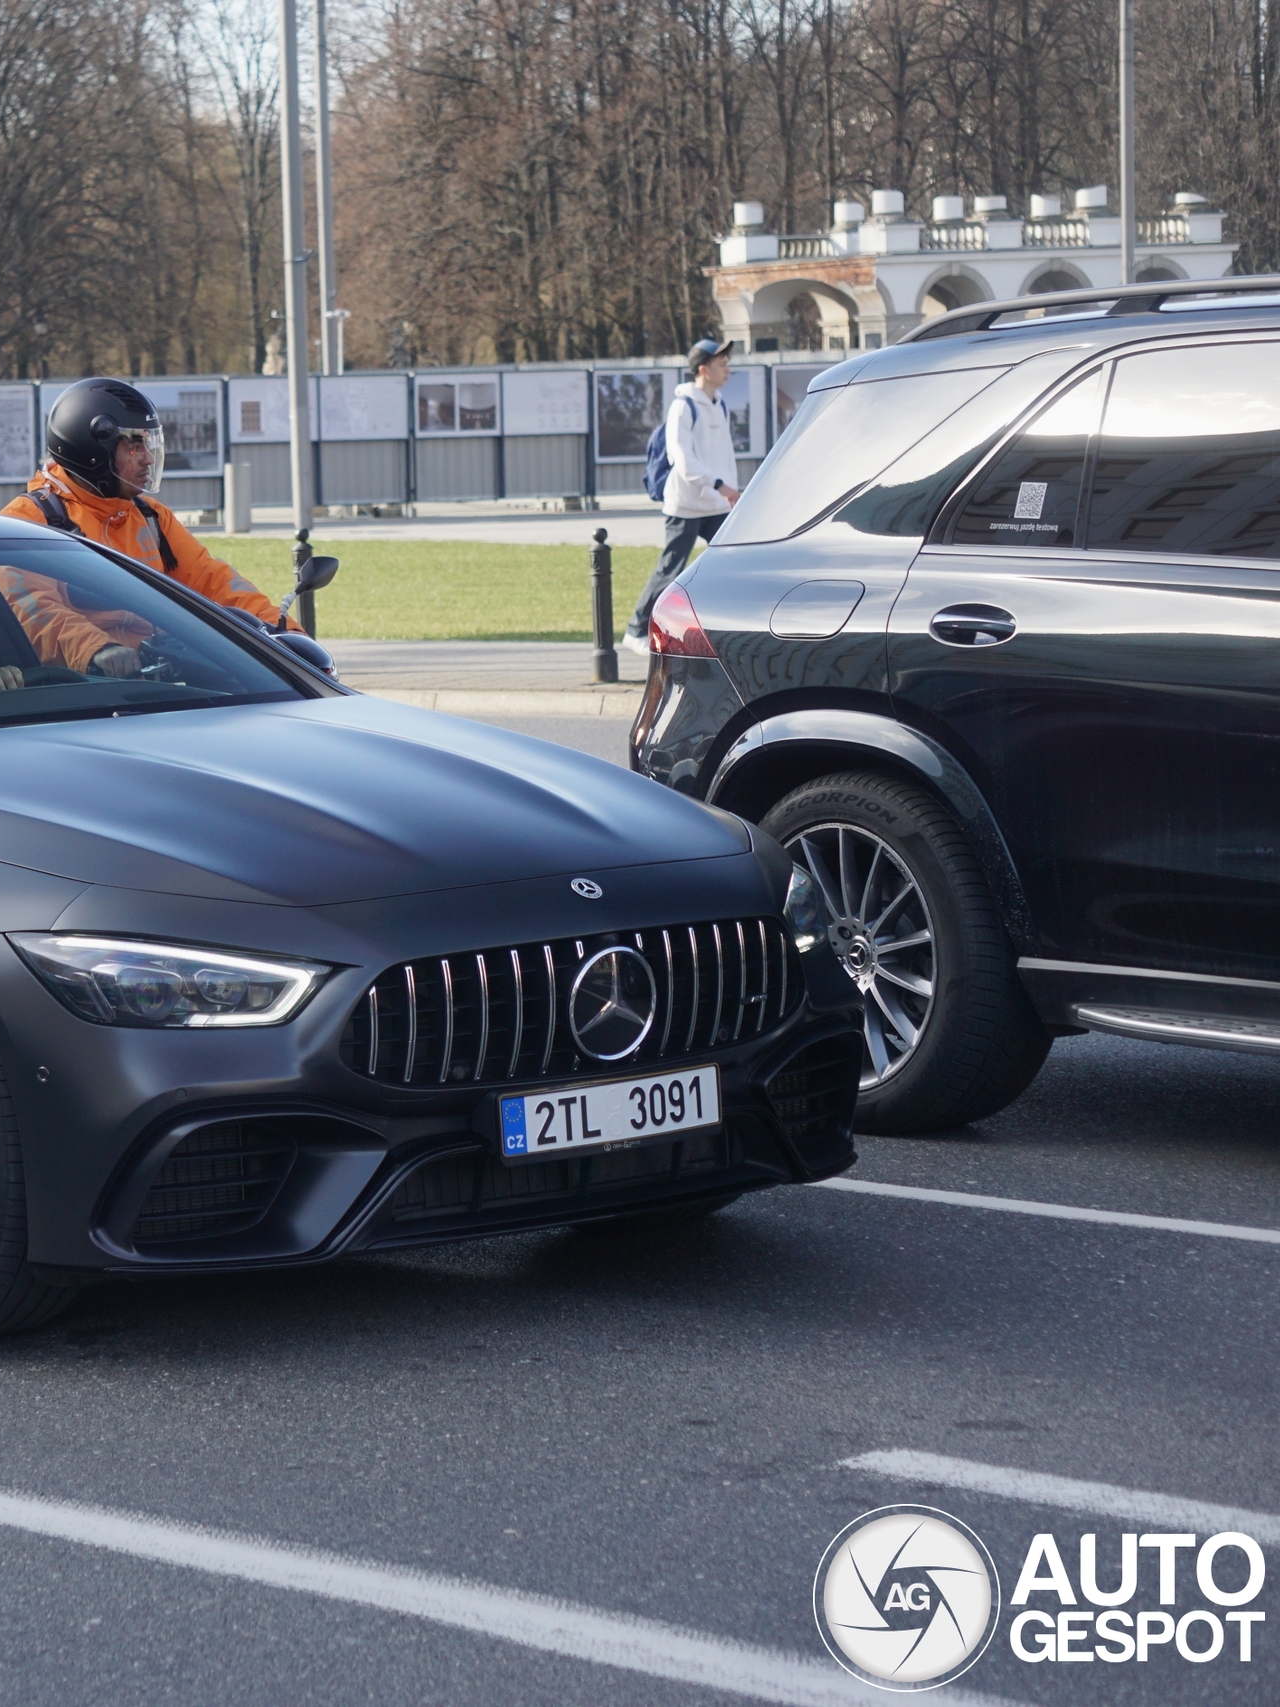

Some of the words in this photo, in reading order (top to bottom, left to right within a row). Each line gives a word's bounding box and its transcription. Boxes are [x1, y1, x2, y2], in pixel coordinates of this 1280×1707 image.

[989, 522, 1019, 532] zarezerwuj
[1019, 522, 1034, 532] jazdę
[1035, 522, 1058, 533] testową
[784, 792, 898, 824] SCORPION
[534, 1095, 602, 1146] 2TL
[628, 1075, 704, 1130] 3091
[506, 1134, 525, 1150] CZ
